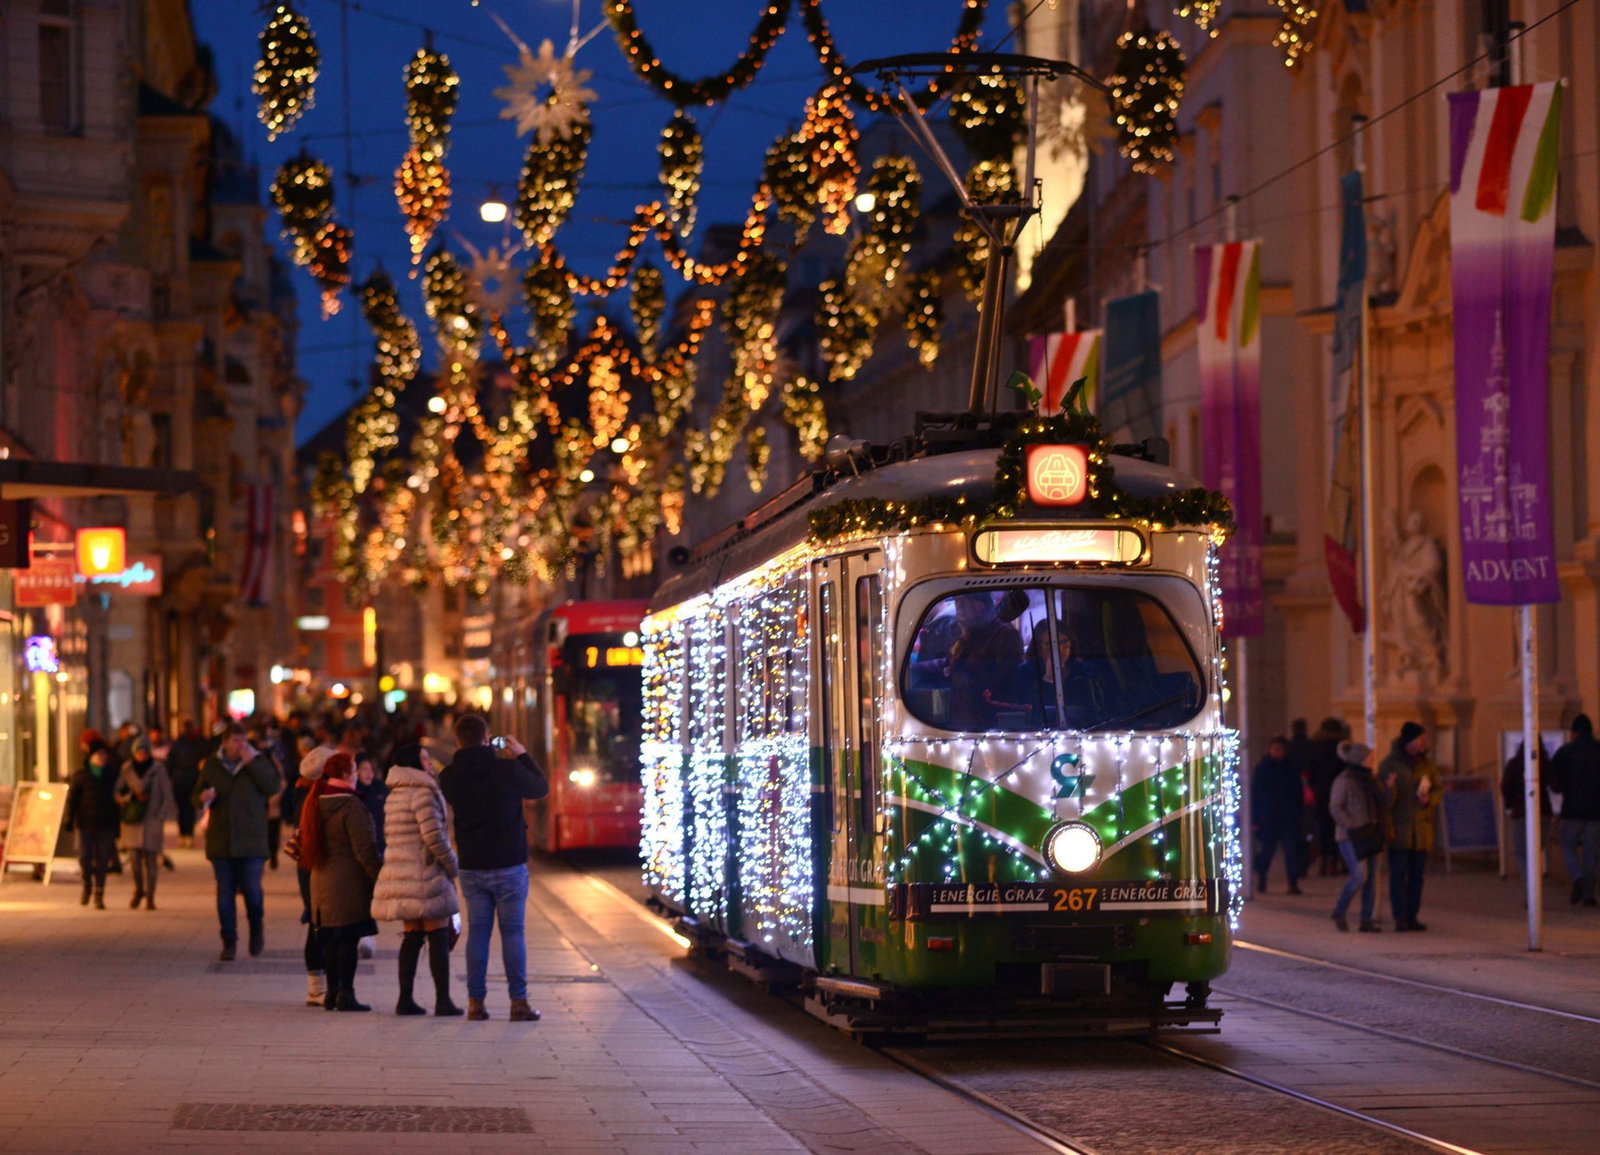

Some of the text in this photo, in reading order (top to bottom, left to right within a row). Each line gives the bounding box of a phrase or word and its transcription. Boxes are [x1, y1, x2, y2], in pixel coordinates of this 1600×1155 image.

[1466, 556, 1549, 581] ADVENT
[940, 888, 1045, 902] ENERGIE GRAZ
[1053, 888, 1097, 911] 267
[1110, 886, 1205, 900] ENERGIE GRAZ
